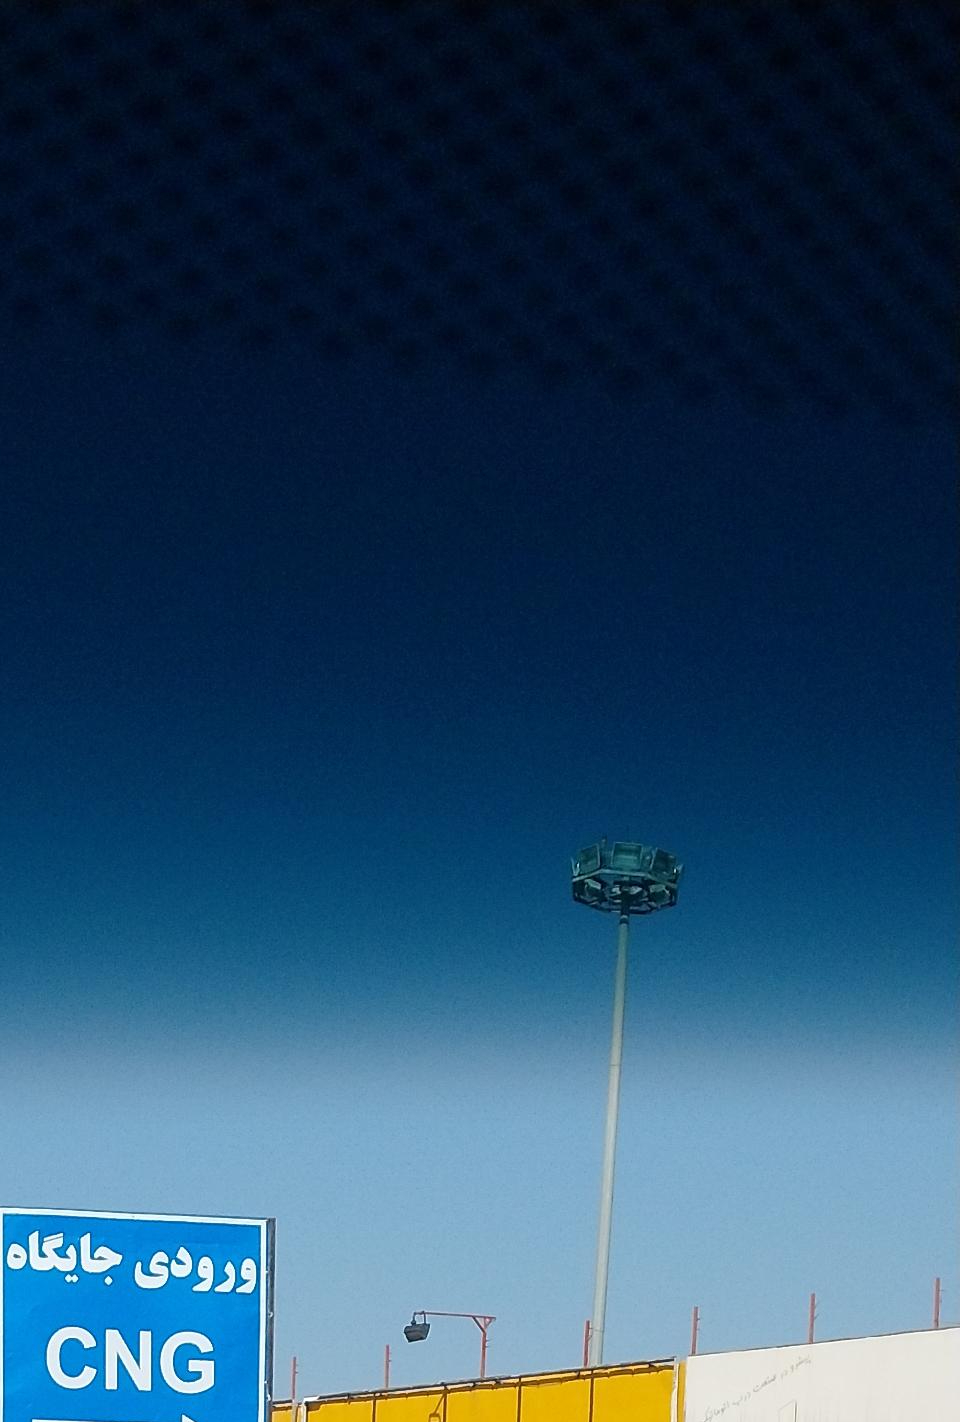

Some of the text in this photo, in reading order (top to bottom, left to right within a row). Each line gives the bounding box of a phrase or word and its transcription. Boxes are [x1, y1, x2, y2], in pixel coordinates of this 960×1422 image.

[6, 1230, 258, 1294] ورودی جایگاه
[46, 1326, 215, 1394] CNG
